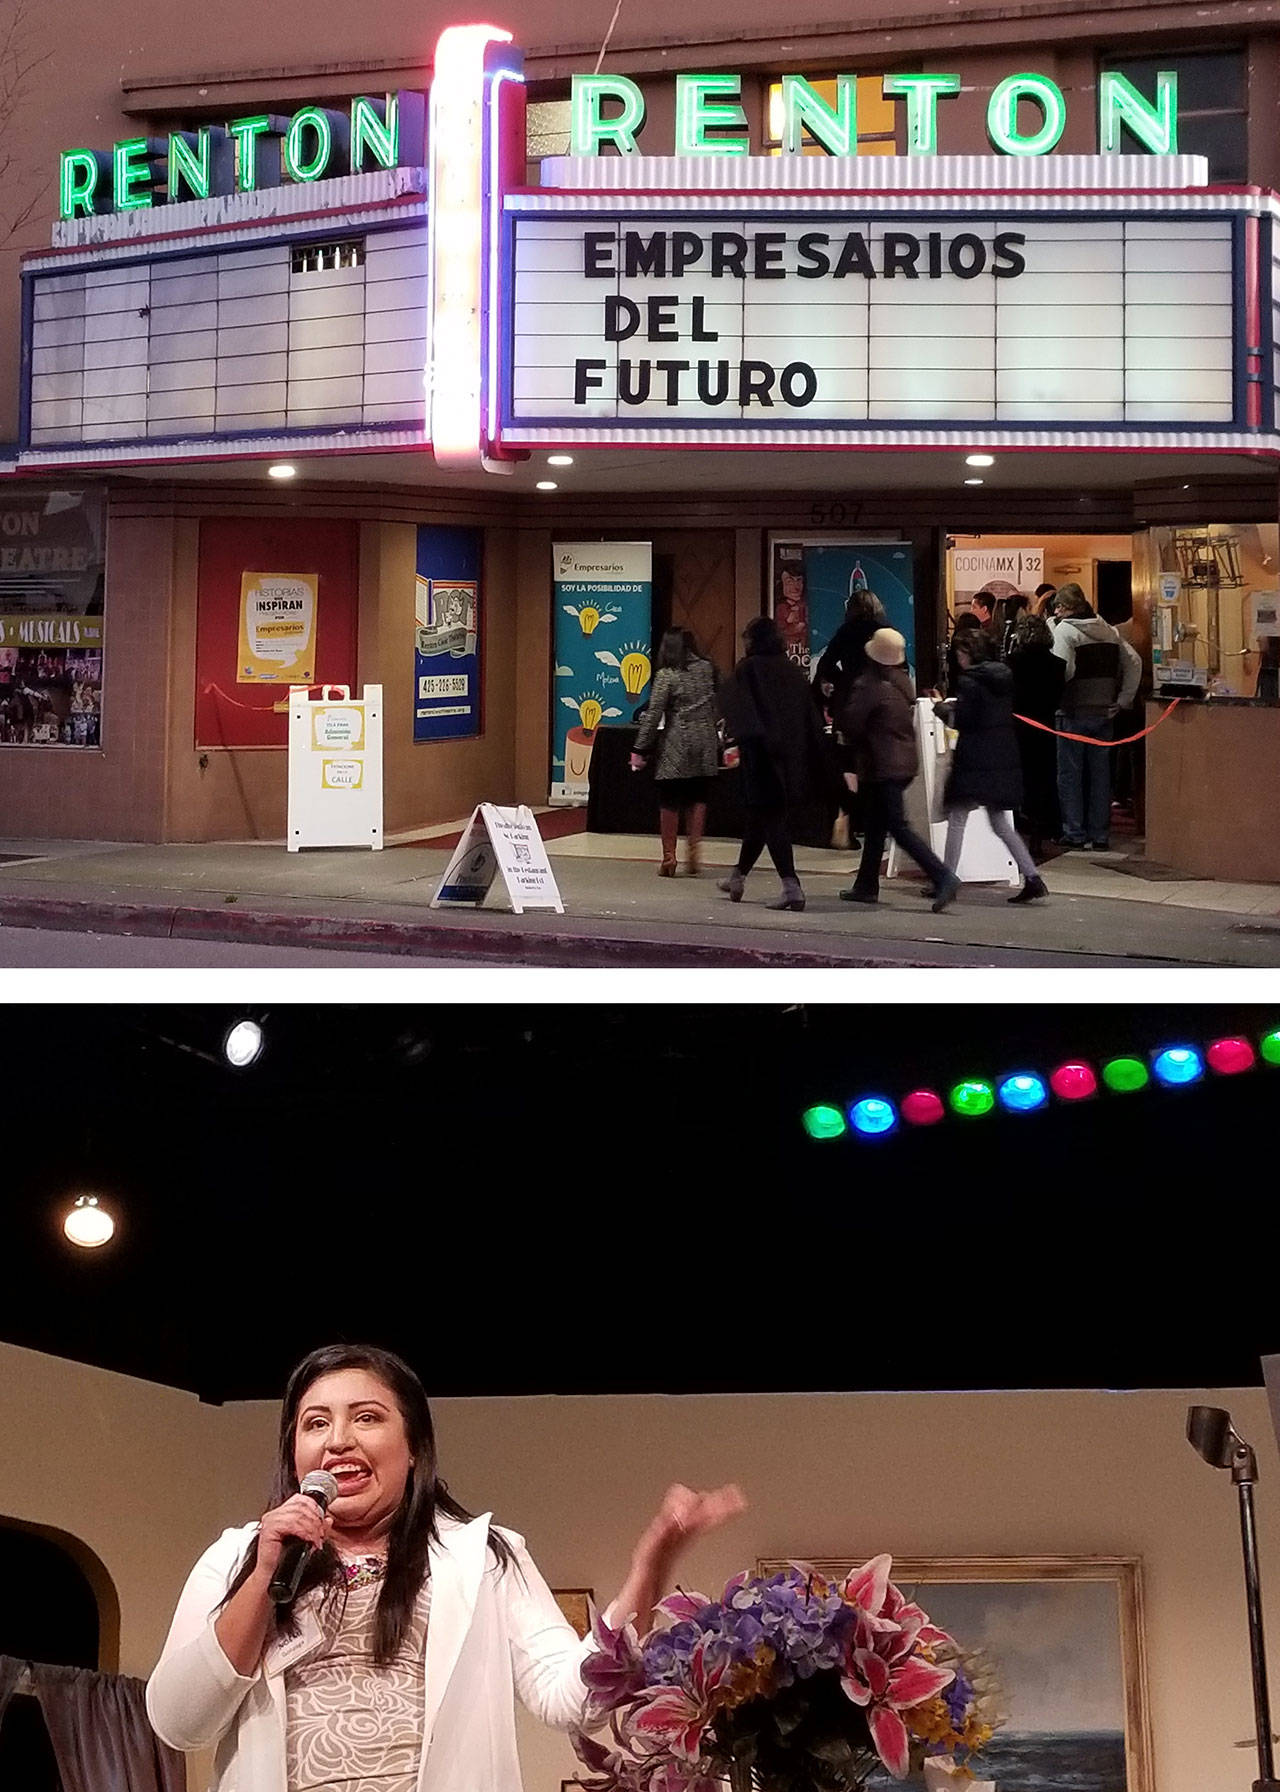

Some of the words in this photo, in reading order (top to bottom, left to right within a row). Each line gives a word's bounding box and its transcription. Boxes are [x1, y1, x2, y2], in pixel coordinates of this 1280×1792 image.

[571, 72, 1179, 156] RENTON
[60, 91, 400, 220] RENTON
[583, 232, 1026, 279] EMPRESARIOS
[604, 295, 719, 342] DEL
[573, 359, 818, 407] FUTURO
[574, 562, 624, 573] Empresarios
[955, 556, 1014, 572] COCINAMX
[1025, 557, 1041, 572] 32
[255, 587, 305, 597] HISTORIAS
[587, 584, 631, 592] POSIBILIDAD
[633, 584, 642, 592] DE
[256, 600, 303, 611] INSPIRAN
[19, 621, 81, 644] MUSICALS
[256, 624, 305, 635] Empresarios
[789, 643, 810, 654] The
